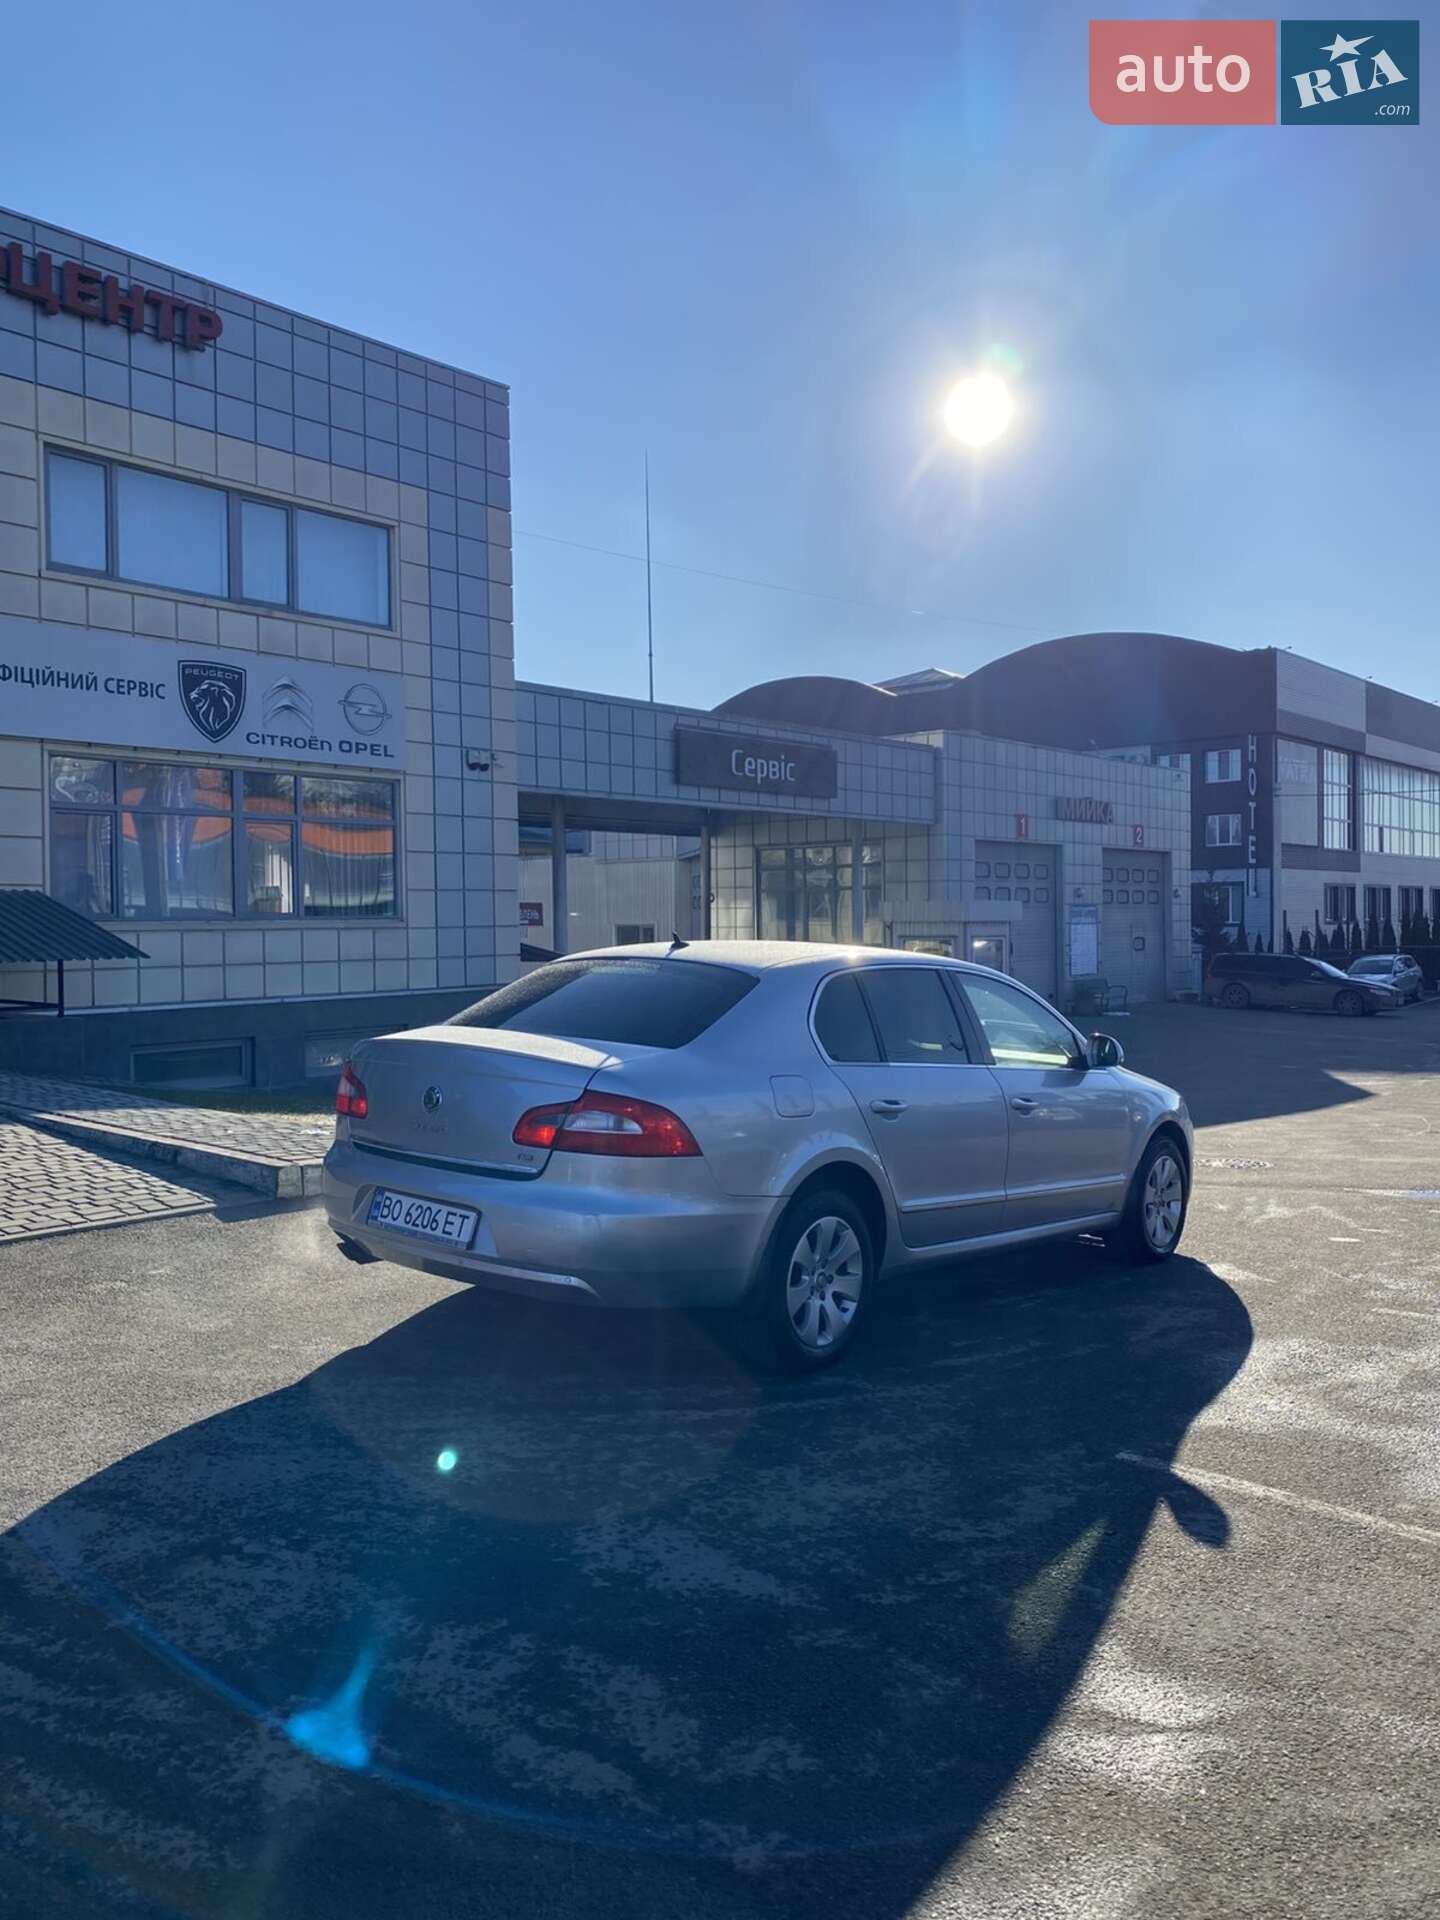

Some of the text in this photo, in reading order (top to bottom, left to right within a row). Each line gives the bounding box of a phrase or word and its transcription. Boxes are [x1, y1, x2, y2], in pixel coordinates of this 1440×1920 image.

[0, 241, 223, 352] ЦЕНТР
[104, 677, 166, 700] СЕРВІС
[184, 668, 239, 681] PEUGEOT
[339, 740, 395, 758] OPEL
[731, 749, 796, 785] Сервіс
[1248, 734, 1257, 898] HOTEL
[1135, 826, 1144, 843] 2
[380, 1196, 470, 1238] BO 6206 ET
